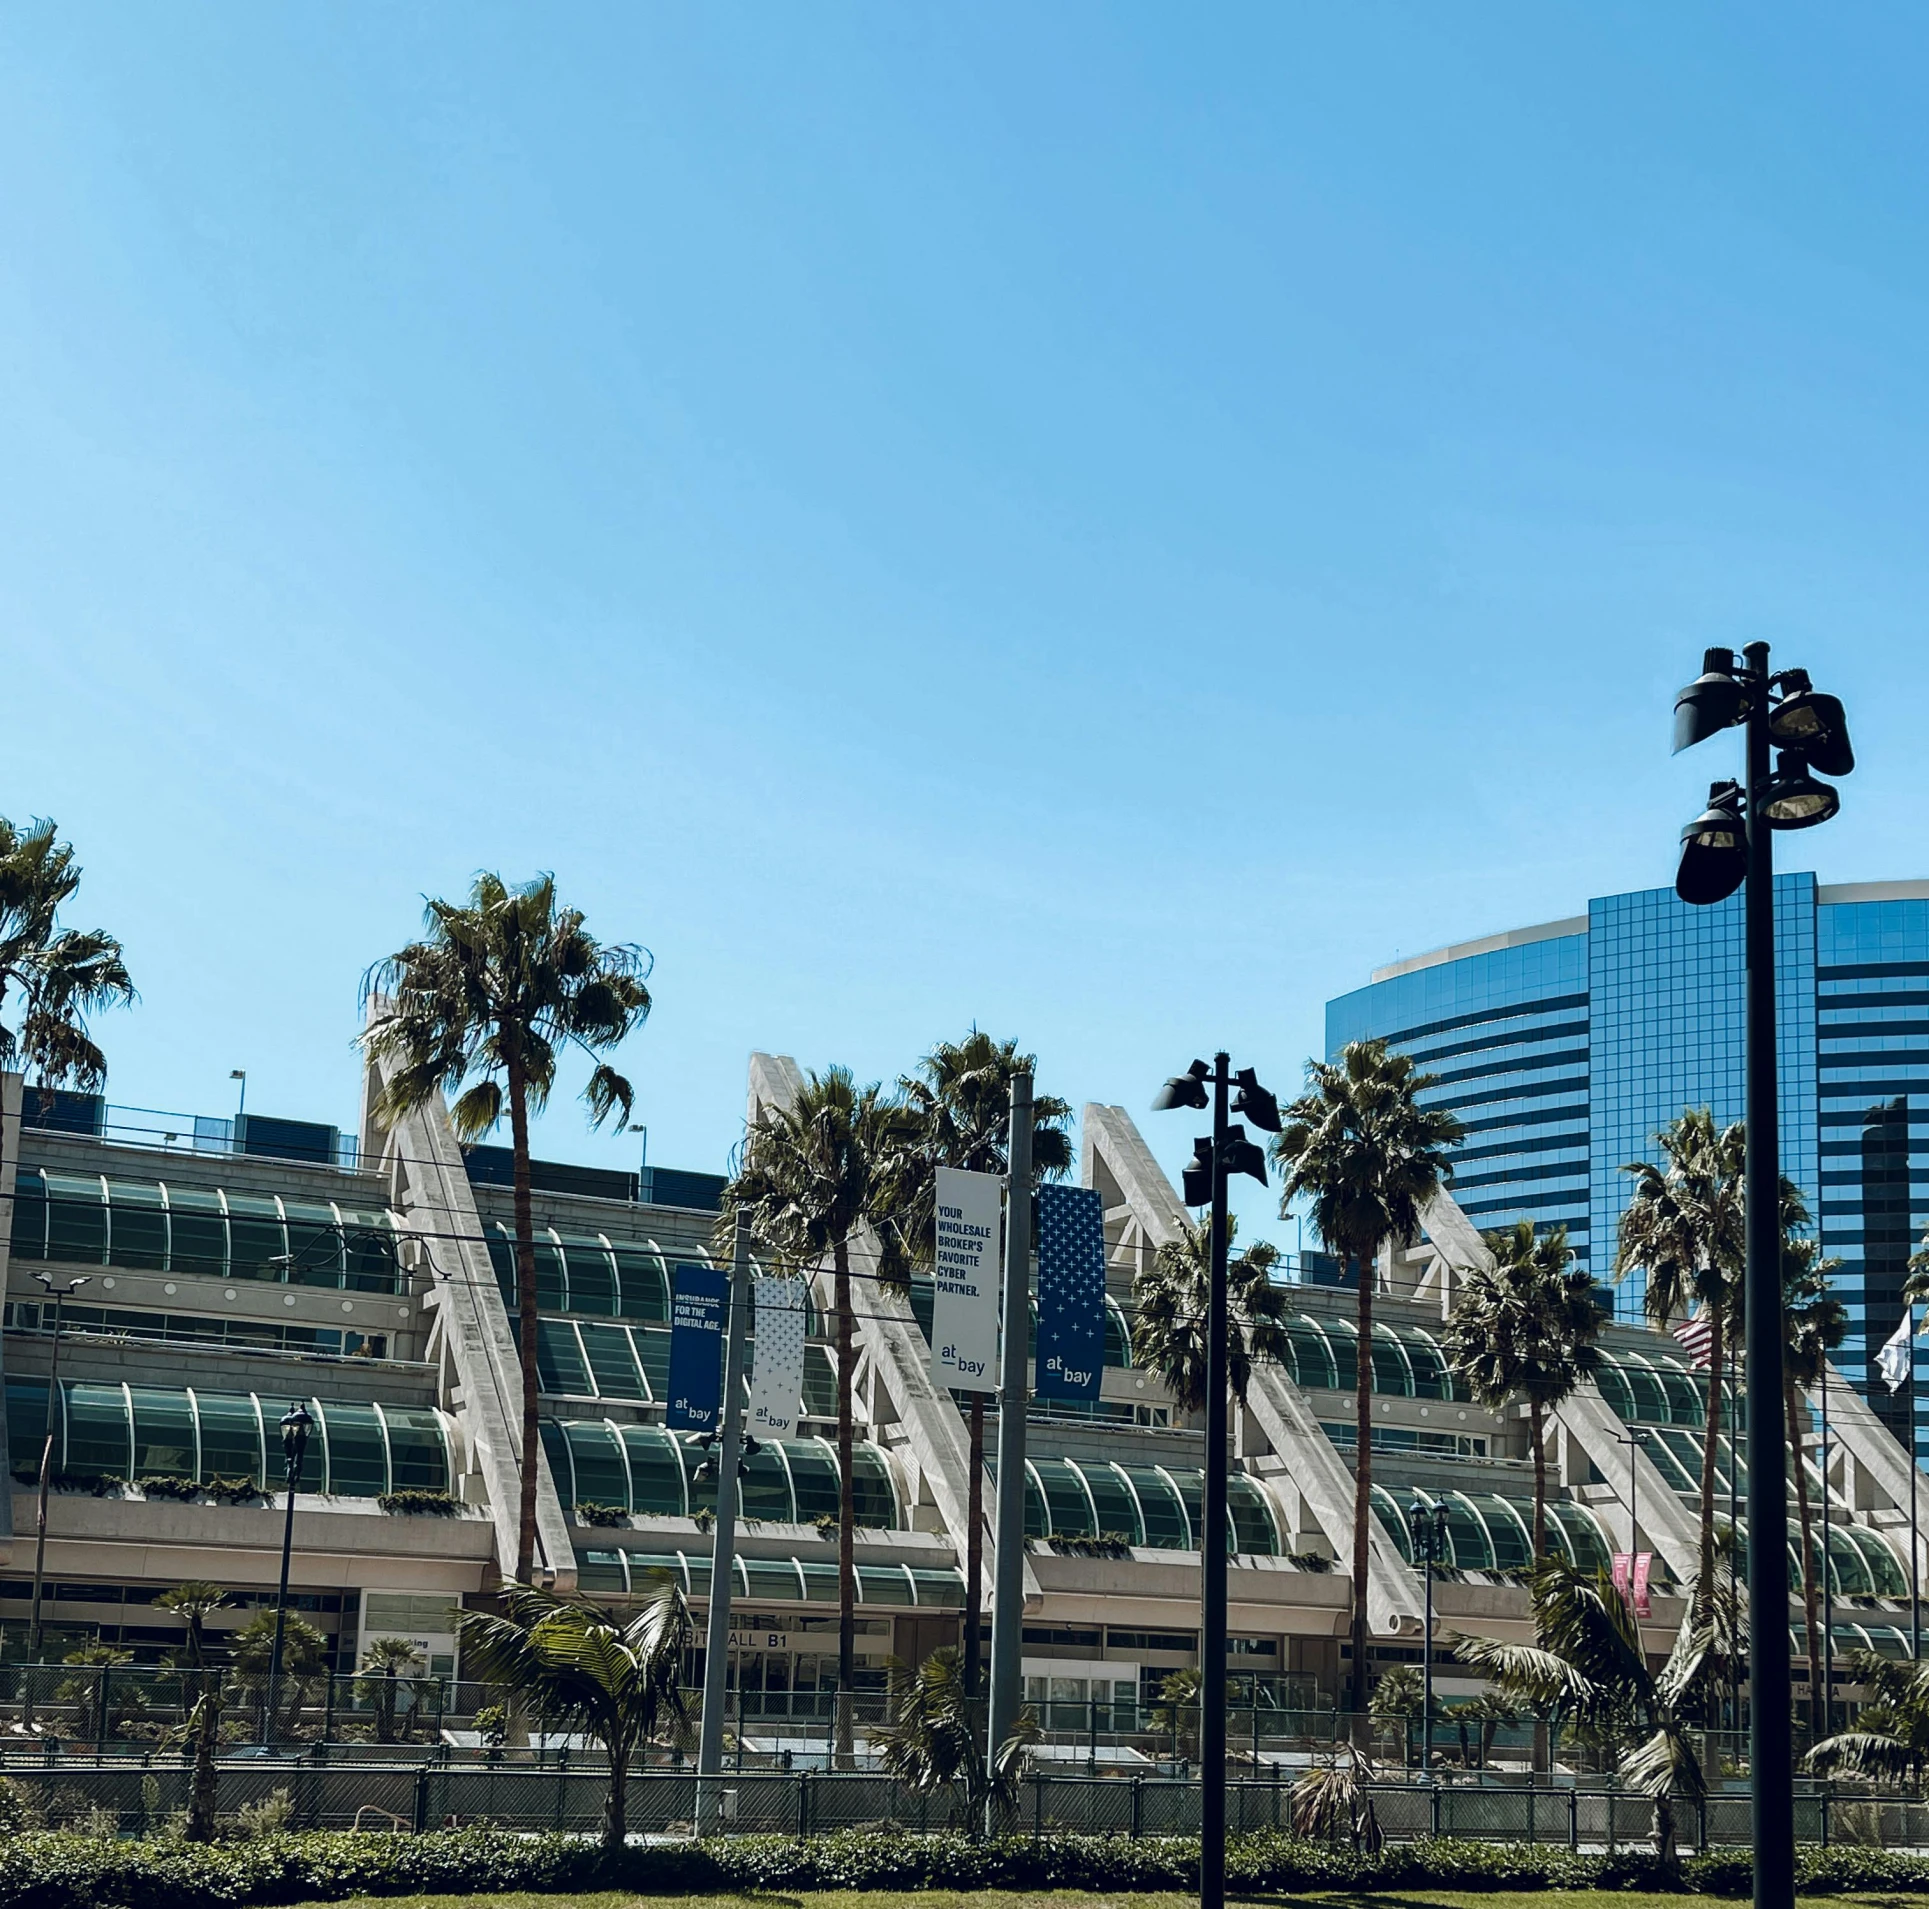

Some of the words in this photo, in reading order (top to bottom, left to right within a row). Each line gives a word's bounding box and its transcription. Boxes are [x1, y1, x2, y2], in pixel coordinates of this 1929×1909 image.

[938, 1205, 963, 1220] YOUR
[938, 1220, 991, 1239] WHOLESALE
[938, 1235, 983, 1253] BROKER'S
[937, 1250, 980, 1267] FAVORITE
[937, 1265, 966, 1281] CYBER
[937, 1280, 980, 1297] PARTNER.
[675, 1293, 720, 1308] INSURANCE
[674, 1305, 690, 1316] FOR
[691, 1306, 706, 1318] THE
[674, 1316, 703, 1329] DIGITAL
[703, 1320, 721, 1331] AGE.
[941, 1344, 957, 1359] at
[958, 1357, 986, 1377] bay
[1046, 1356, 1063, 1370] at
[1063, 1367, 1092, 1387] bay
[675, 1398, 688, 1409] at
[688, 1407, 711, 1422] bay
[756, 1406, 769, 1418] at
[768, 1415, 790, 1430] bay
[727, 1632, 757, 1647] ALL
[768, 1634, 787, 1648] B1
